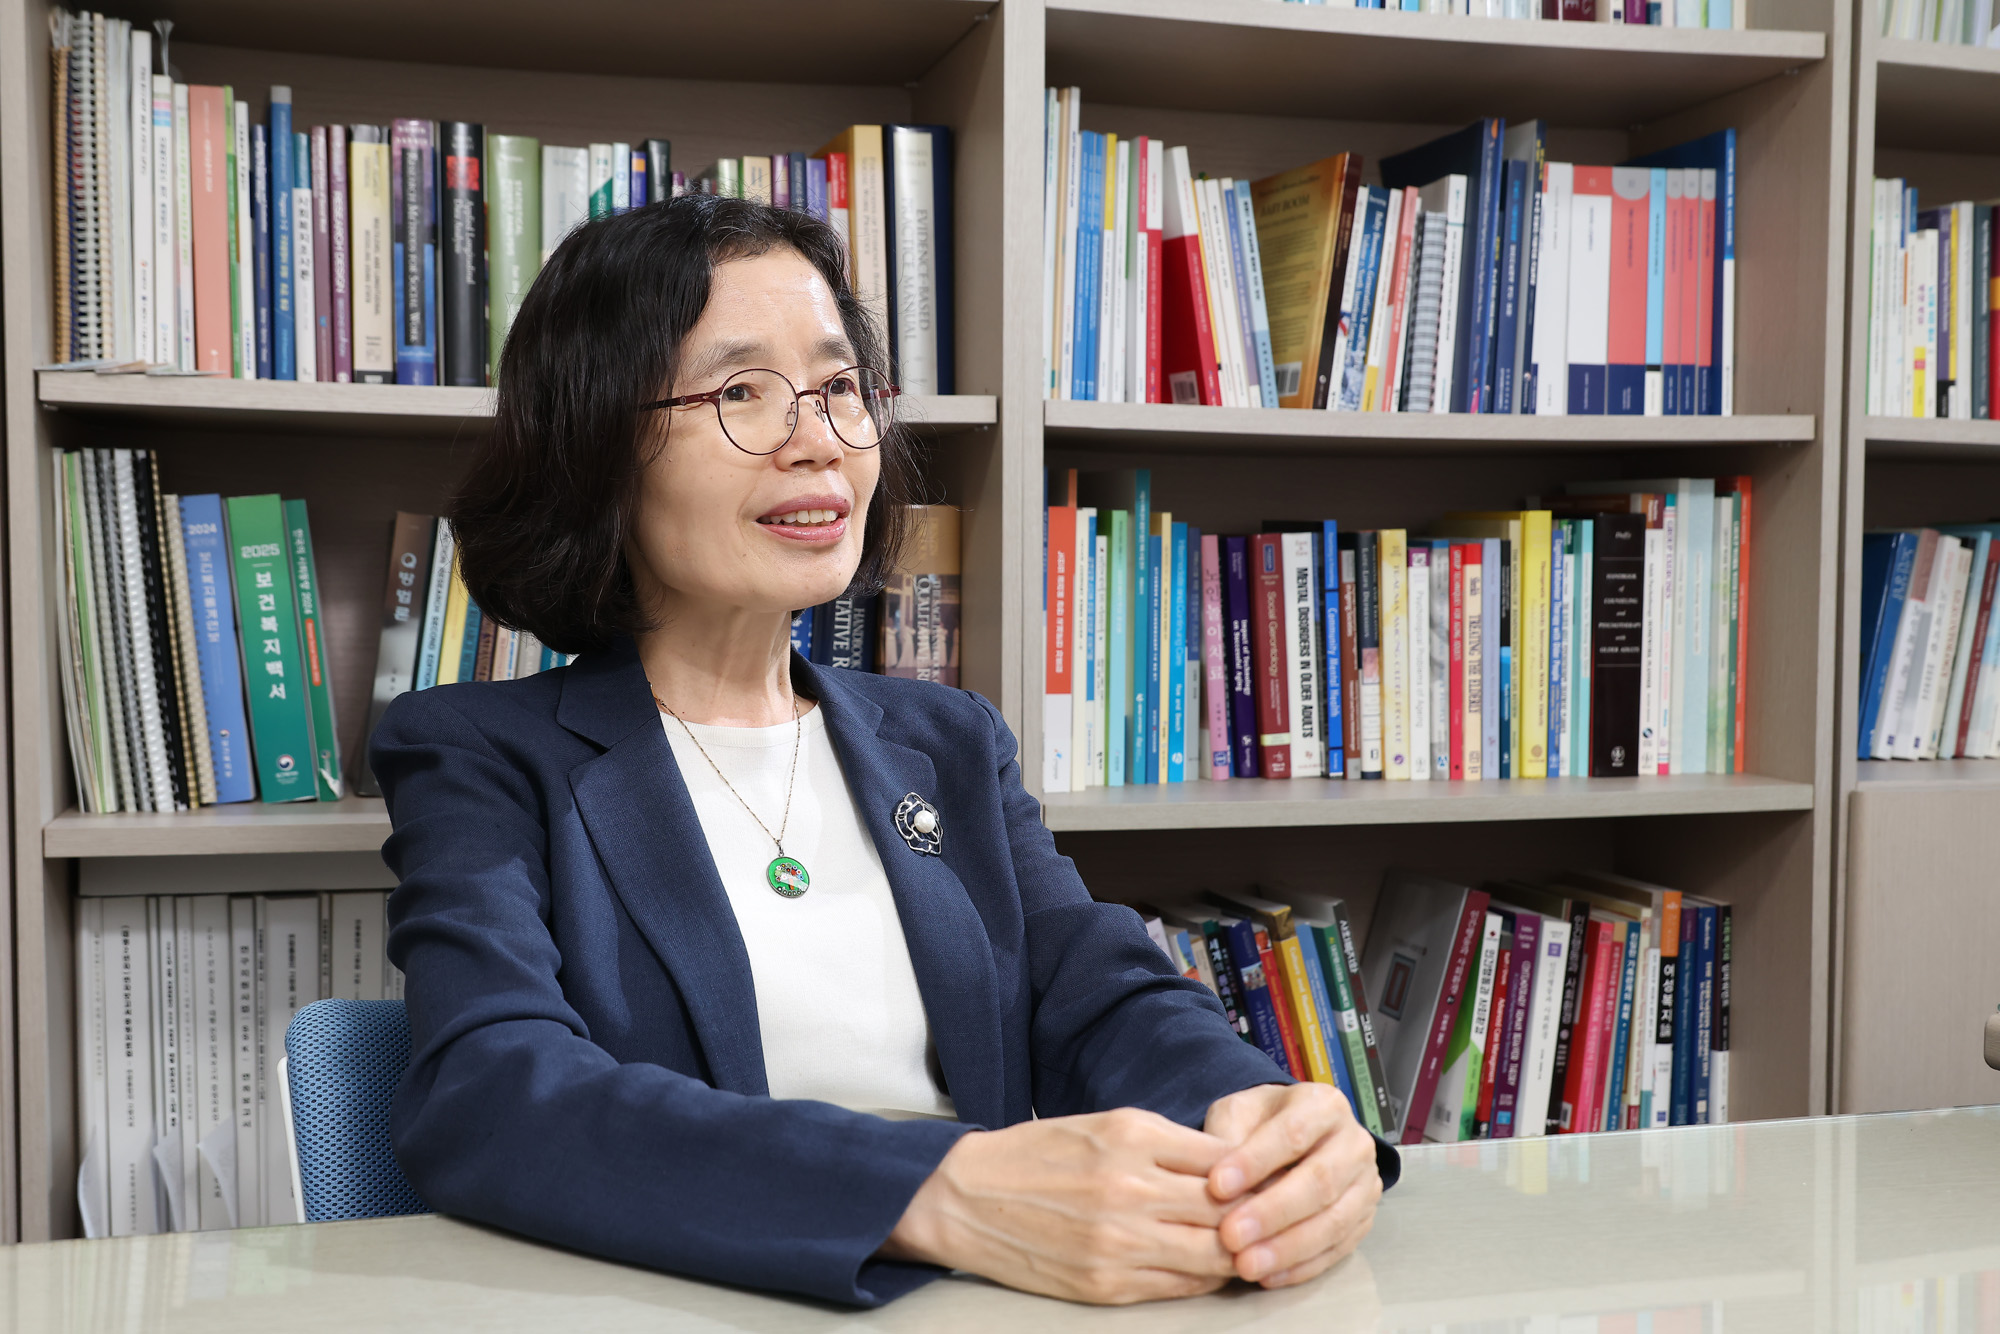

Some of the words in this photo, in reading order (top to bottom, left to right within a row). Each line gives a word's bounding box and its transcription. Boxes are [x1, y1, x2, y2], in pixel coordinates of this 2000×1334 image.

[333, 190, 345, 250] RESEARCH
[334, 252, 346, 292] DESIGN
[916, 209, 930, 330] EVIDENCE-BASED
[903, 275, 916, 340] MANUAL
[188, 523, 218, 535] 2024
[241, 543, 281, 558] 2025
[1554, 539, 1562, 568] Cognitive
[292, 528, 306, 554] 한국의
[299, 592, 312, 614] 2024
[1297, 568, 1309, 604] MENTAL
[916, 576, 931, 663] QUALITATIVE
[1267, 591, 1277, 619] Social
[1415, 590, 1424, 644] Psychological
[256, 572, 286, 699] 보건복지백서
[428, 616, 441, 650] SECOND
[833, 598, 852, 651] TATIVE
[850, 608, 865, 669] HANDBOOK
[1233, 620, 1240, 630] on
[1240, 619, 1249, 644] Impact
[1298, 607, 1310, 657] DISORDERS
[1327, 608, 1338, 654] Community
[1469, 615, 1481, 656] TREATING
[1553, 628, 1561, 640] with
[1233, 632, 1242, 669] Successful
[1241, 646, 1249, 654] of
[1267, 621, 1279, 677] Gerontology
[1299, 660, 1311, 670] IN
[424, 654, 437, 687] EDITION
[1234, 671, 1243, 692] Aging
[1241, 656, 1251, 696] Technology
[1328, 657, 1339, 688] Mental
[1415, 648, 1425, 685] Problems
[1469, 660, 1481, 676] THE
[1300, 673, 1311, 701] OLDER
[1329, 690, 1340, 717] Health
[1416, 688, 1425, 696] of
[1469, 680, 1481, 713] ELDERLY
[1301, 705, 1312, 738] ADULTS
[1659, 963, 1676, 1039] 여성복지론
[1253, 1010, 1272, 1044] HUMAN
[1360, 1014, 1376, 1047] 그리고
